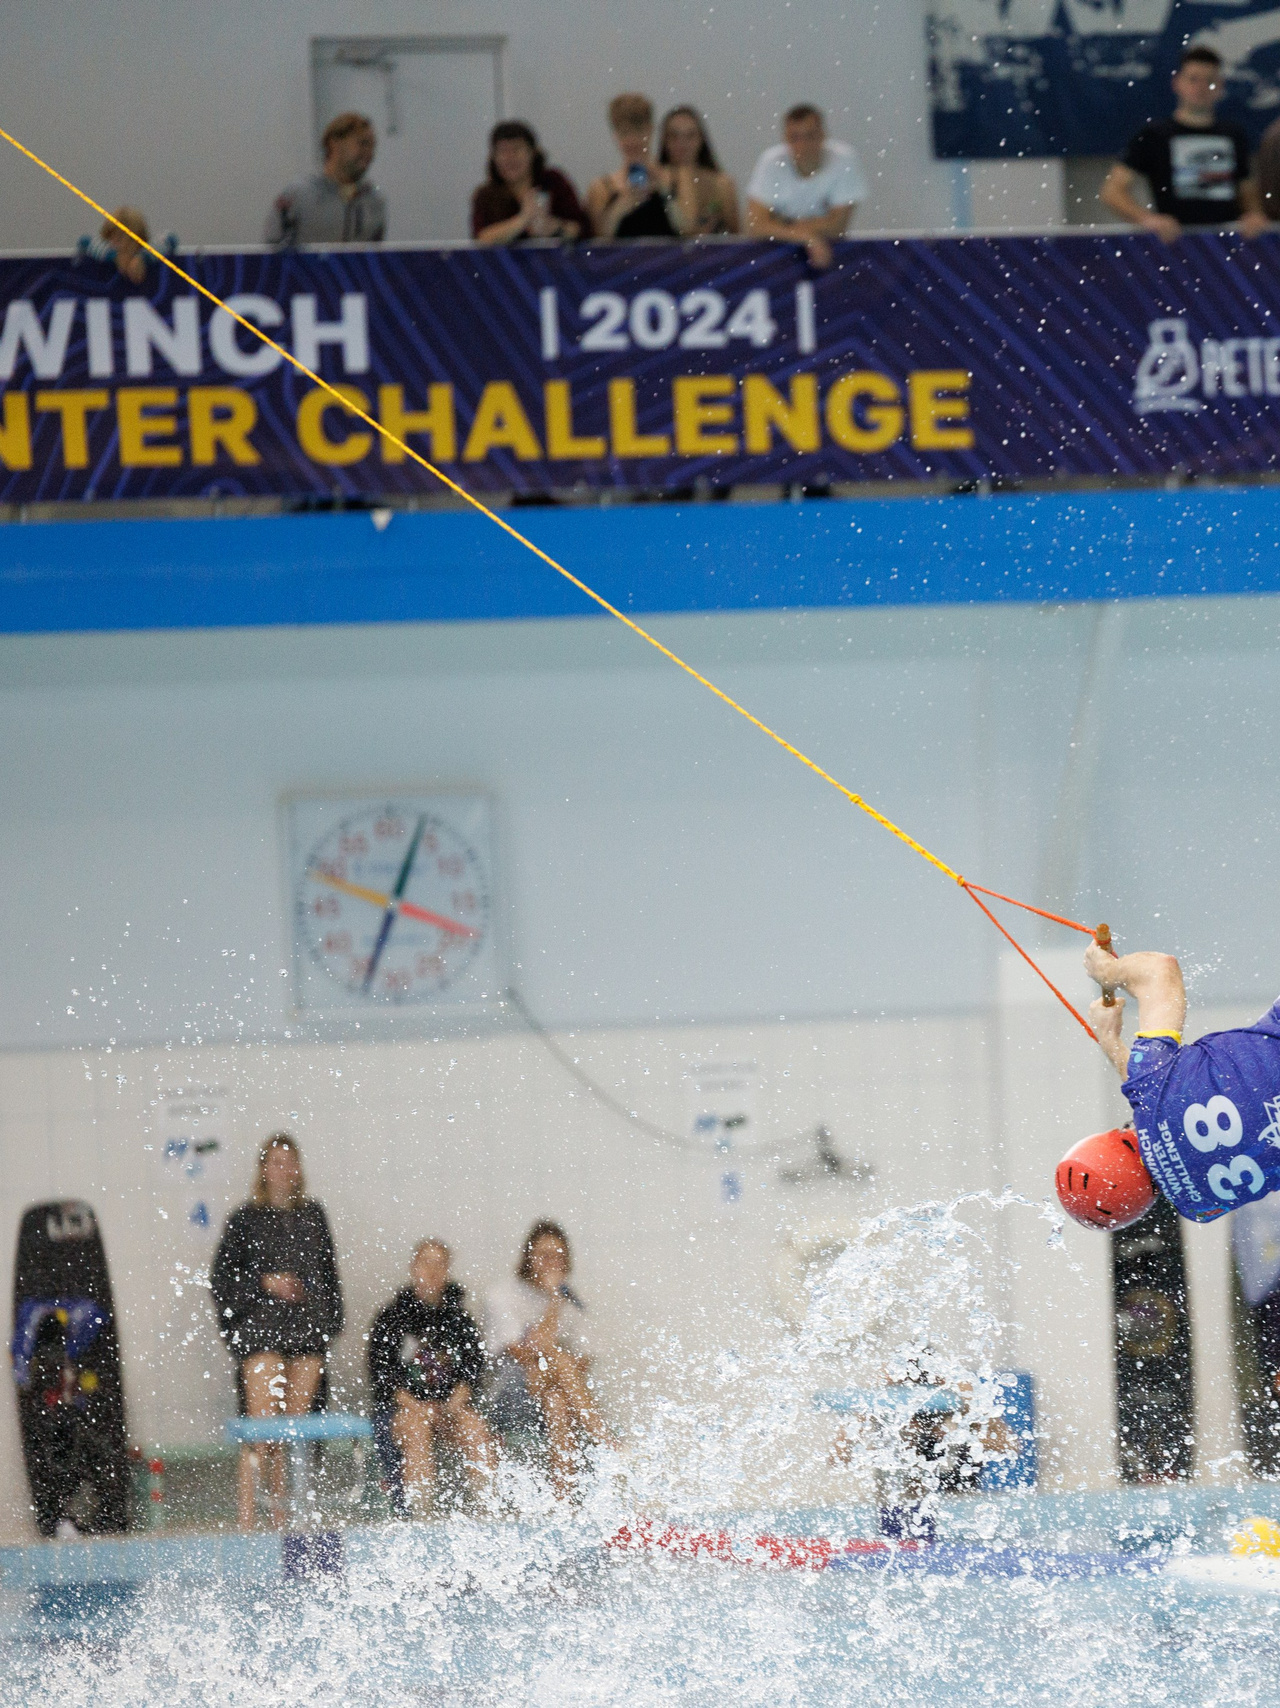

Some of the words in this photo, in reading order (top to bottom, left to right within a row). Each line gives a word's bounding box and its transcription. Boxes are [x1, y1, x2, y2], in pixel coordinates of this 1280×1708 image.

[0, 293, 370, 379] WINCH
[579, 288, 777, 351] 2024
[296, 369, 975, 467] CHALLENGE
[1152, 1140, 1183, 1196] WINTER
[1157, 1119, 1202, 1203] CHALLENGE
[1183, 1095, 1265, 1200] 38
